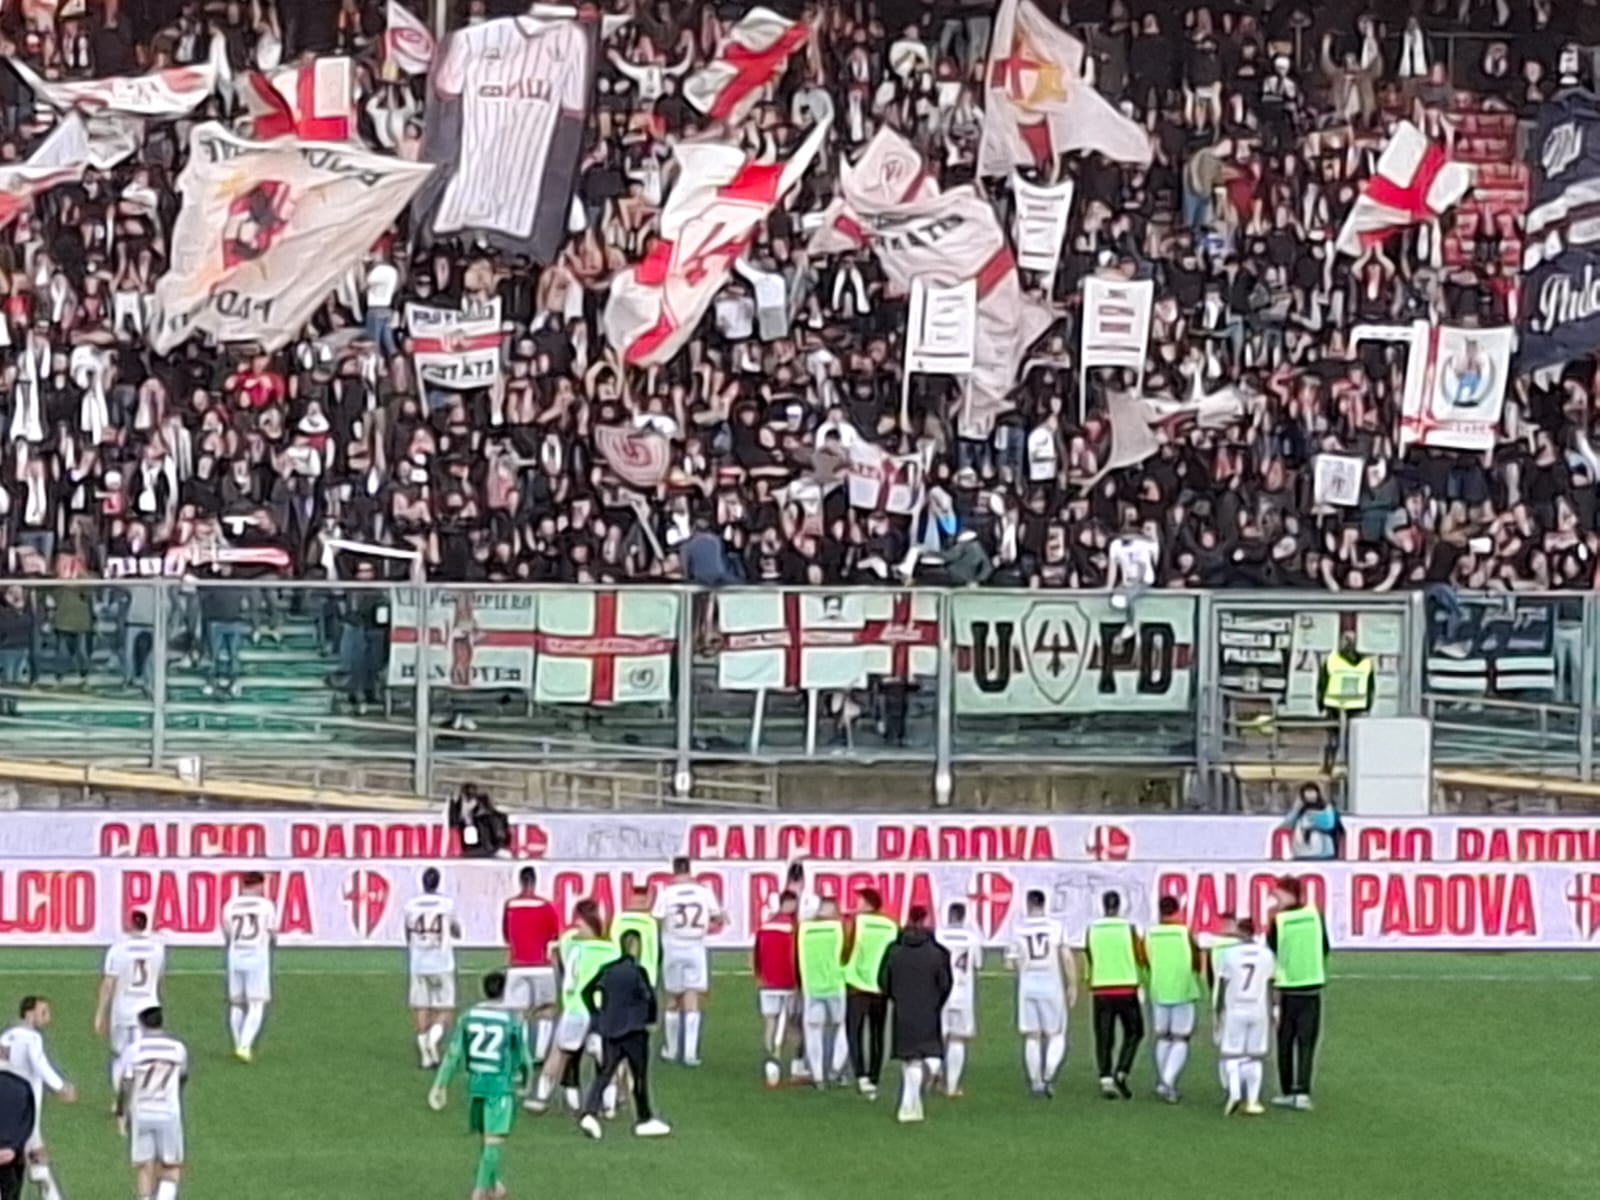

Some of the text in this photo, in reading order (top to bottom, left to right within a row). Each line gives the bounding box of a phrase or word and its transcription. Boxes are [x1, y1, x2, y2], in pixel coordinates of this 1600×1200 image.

[671, 902, 705, 929] 32
[1352, 874, 1536, 936] PADOVA
[1241, 963, 1255, 991] 7
[468, 1023, 503, 1060] 22
